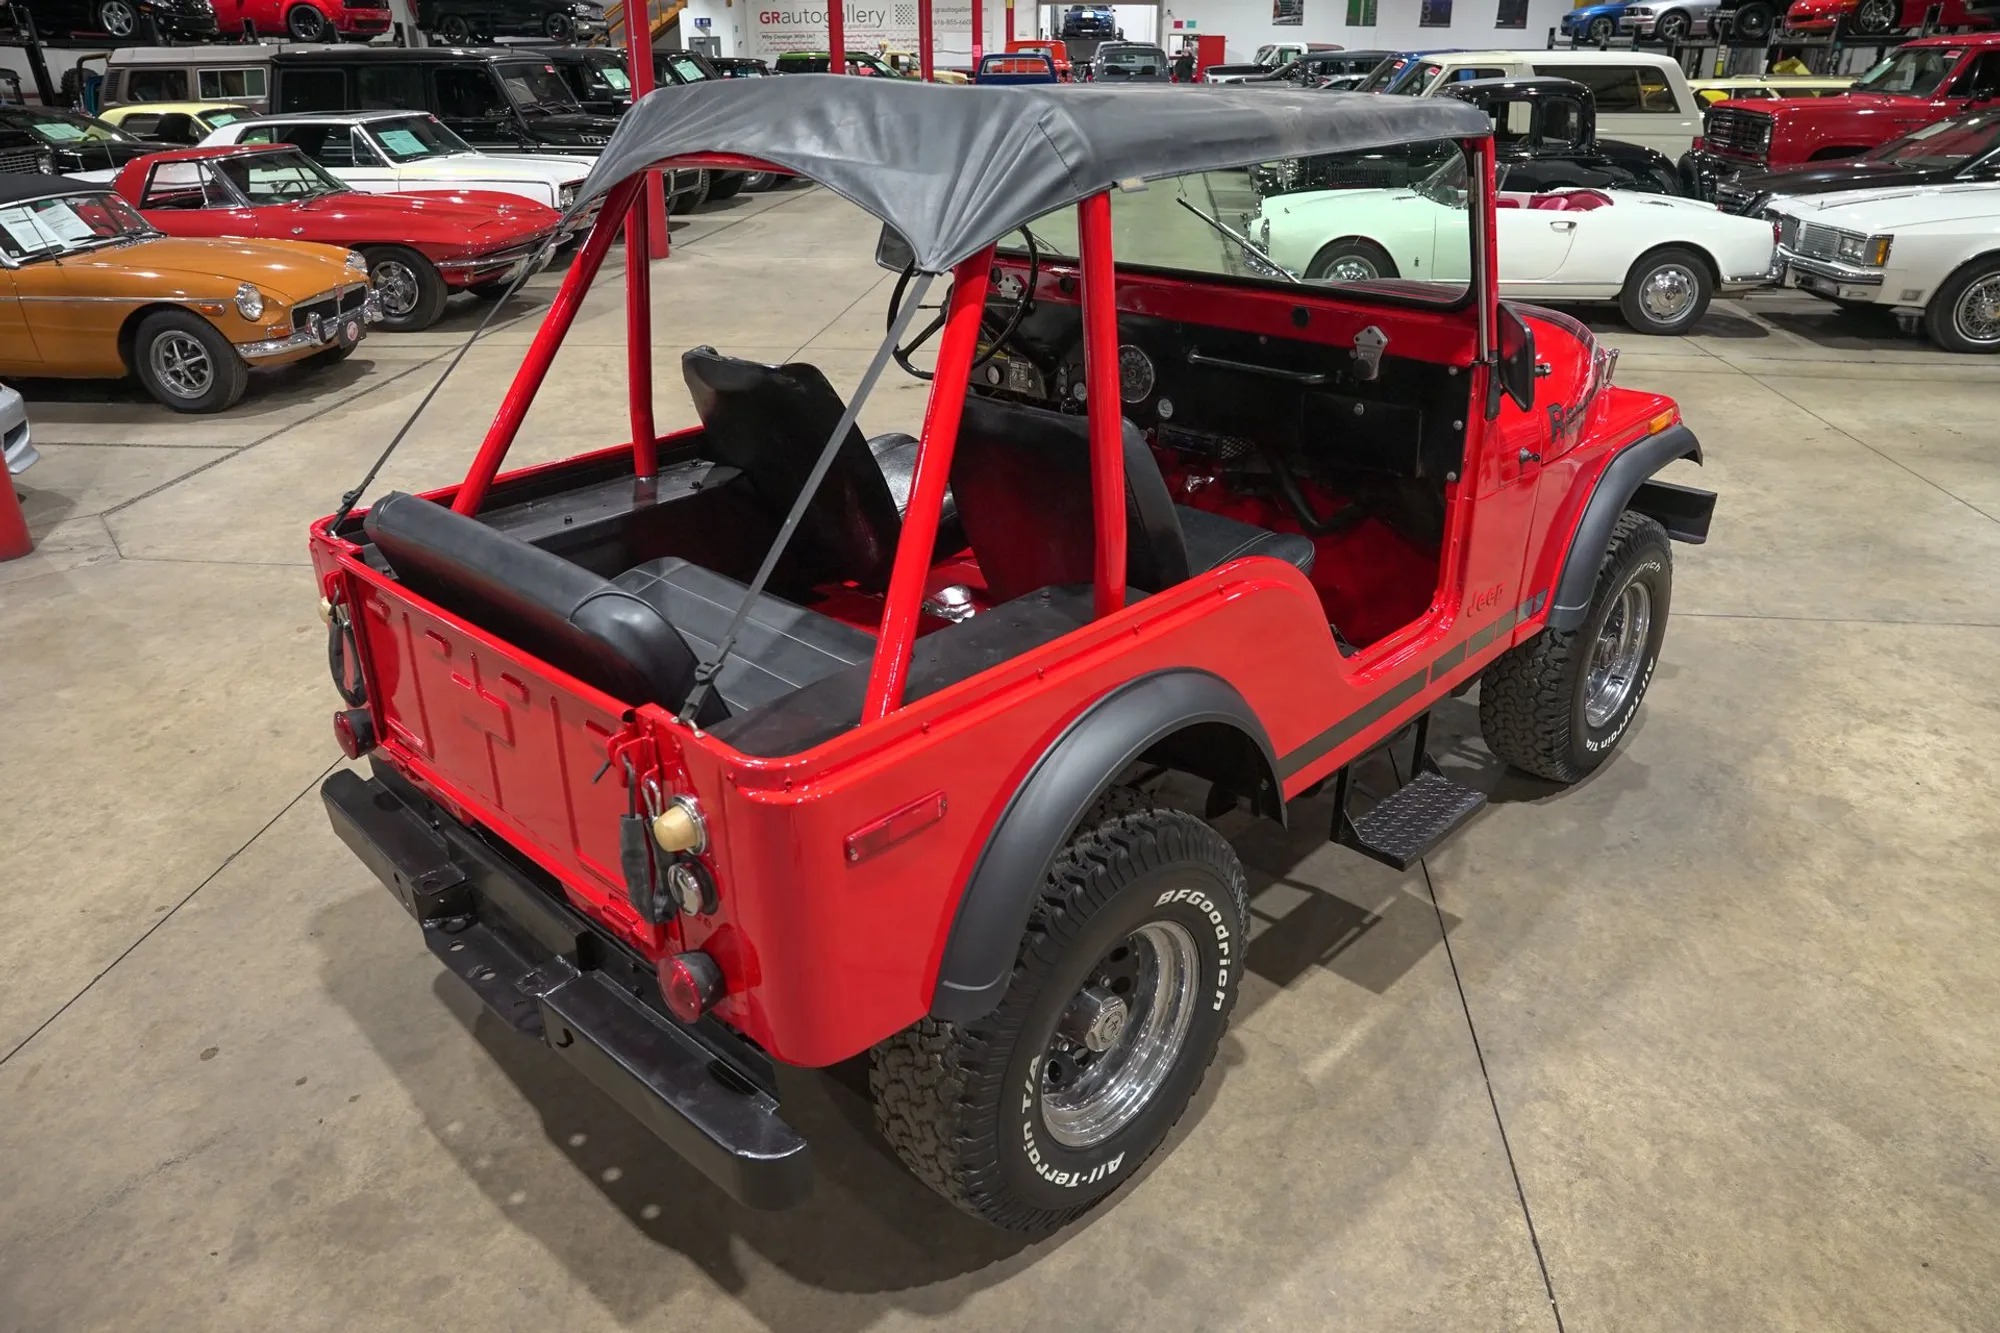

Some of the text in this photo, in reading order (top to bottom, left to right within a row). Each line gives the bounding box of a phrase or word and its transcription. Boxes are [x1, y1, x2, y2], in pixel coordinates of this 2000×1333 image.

[759, 4, 886, 28] GRautollery
[1467, 582, 1504, 618] Jeep
[1586, 738, 1599, 752] T/A
[1154, 888, 1231, 1012] BFGoodrich
[1021, 1054, 1126, 1188] All-Terrain T/A
